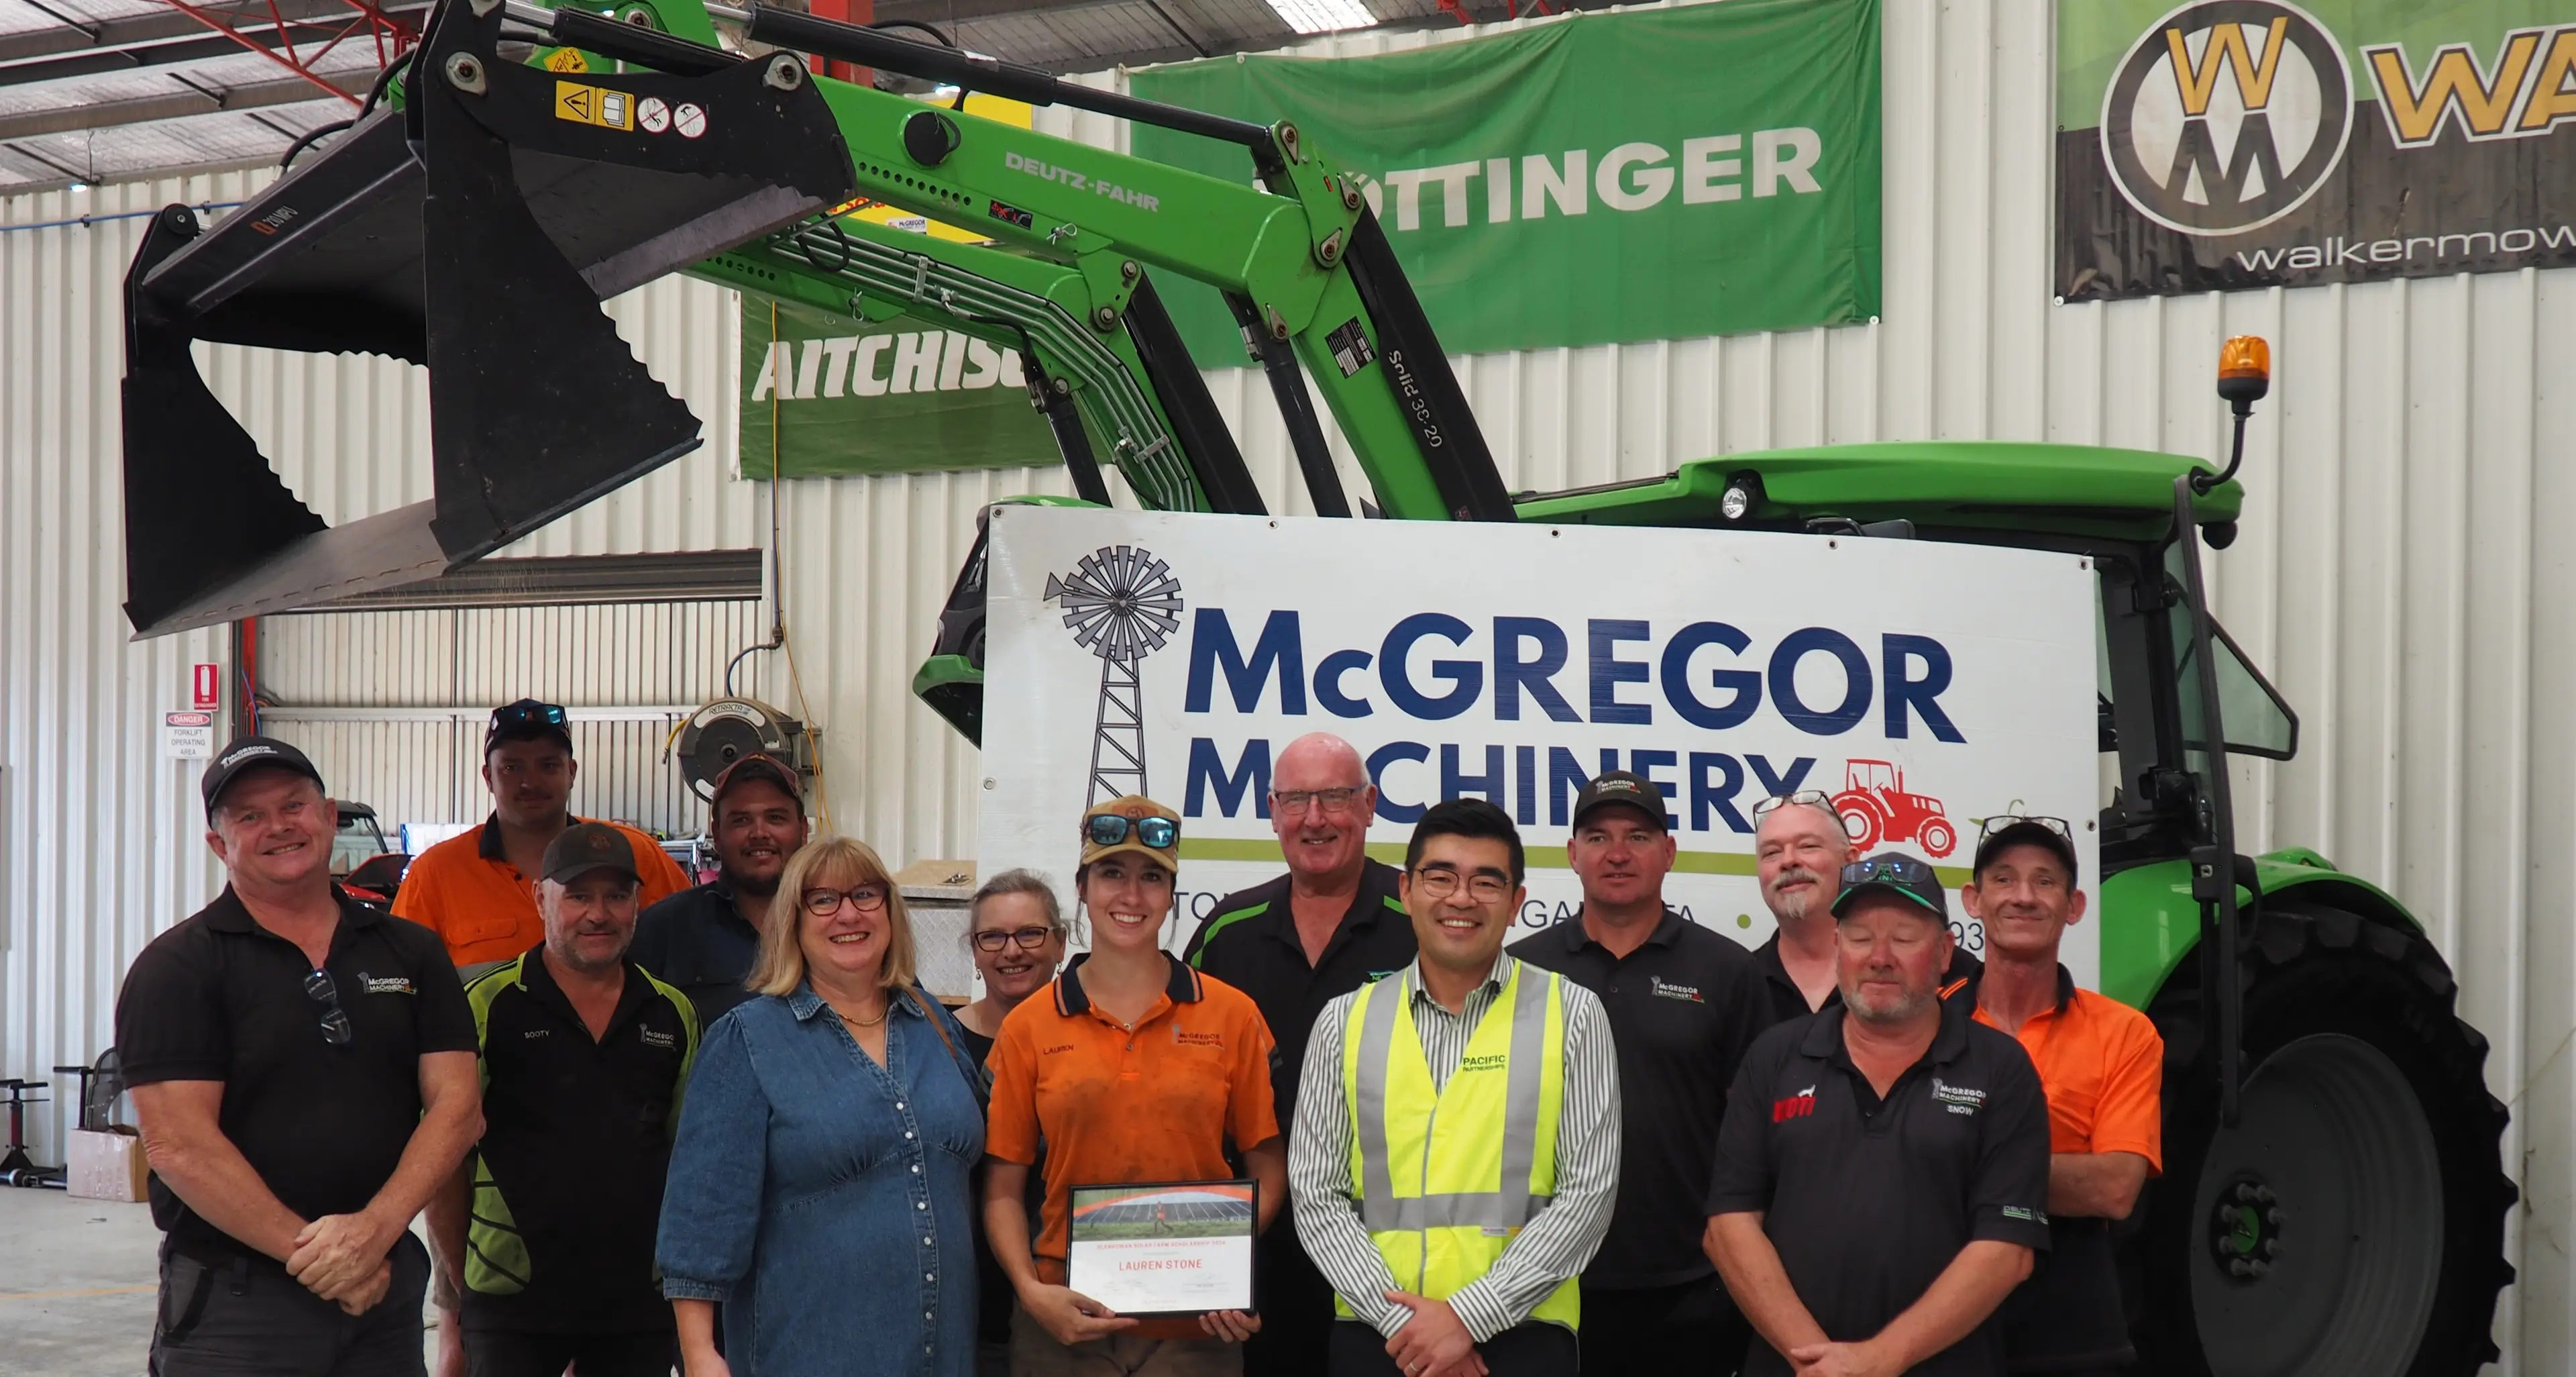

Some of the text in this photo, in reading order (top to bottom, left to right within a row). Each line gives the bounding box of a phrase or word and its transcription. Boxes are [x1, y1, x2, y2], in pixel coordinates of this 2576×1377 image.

[1006, 152, 1159, 212] DEUTZ-FAHR
[1389, 350, 1419, 397] Solid
[1185, 608, 1968, 744] McGREGOR
[174, 715, 203, 723] DANGER
[171, 738, 206, 746] OPERATING
[1183, 737, 1817, 833] MCHINERY
[1659, 983, 1698, 994] McGREGOR
[1658, 990, 1693, 999] MACHINERY
[525, 1029, 549, 1038] SOOTY
[645, 1030, 674, 1040] McGREGO
[1043, 1045, 1073, 1055] LAUREN
[1463, 1054, 1505, 1066] PACIFIC
[1939, 1092, 1980, 1104] MACHINERY
[1947, 1105, 1974, 1116] SNOW
[1119, 1258, 1203, 1271] LAUREN STONE
